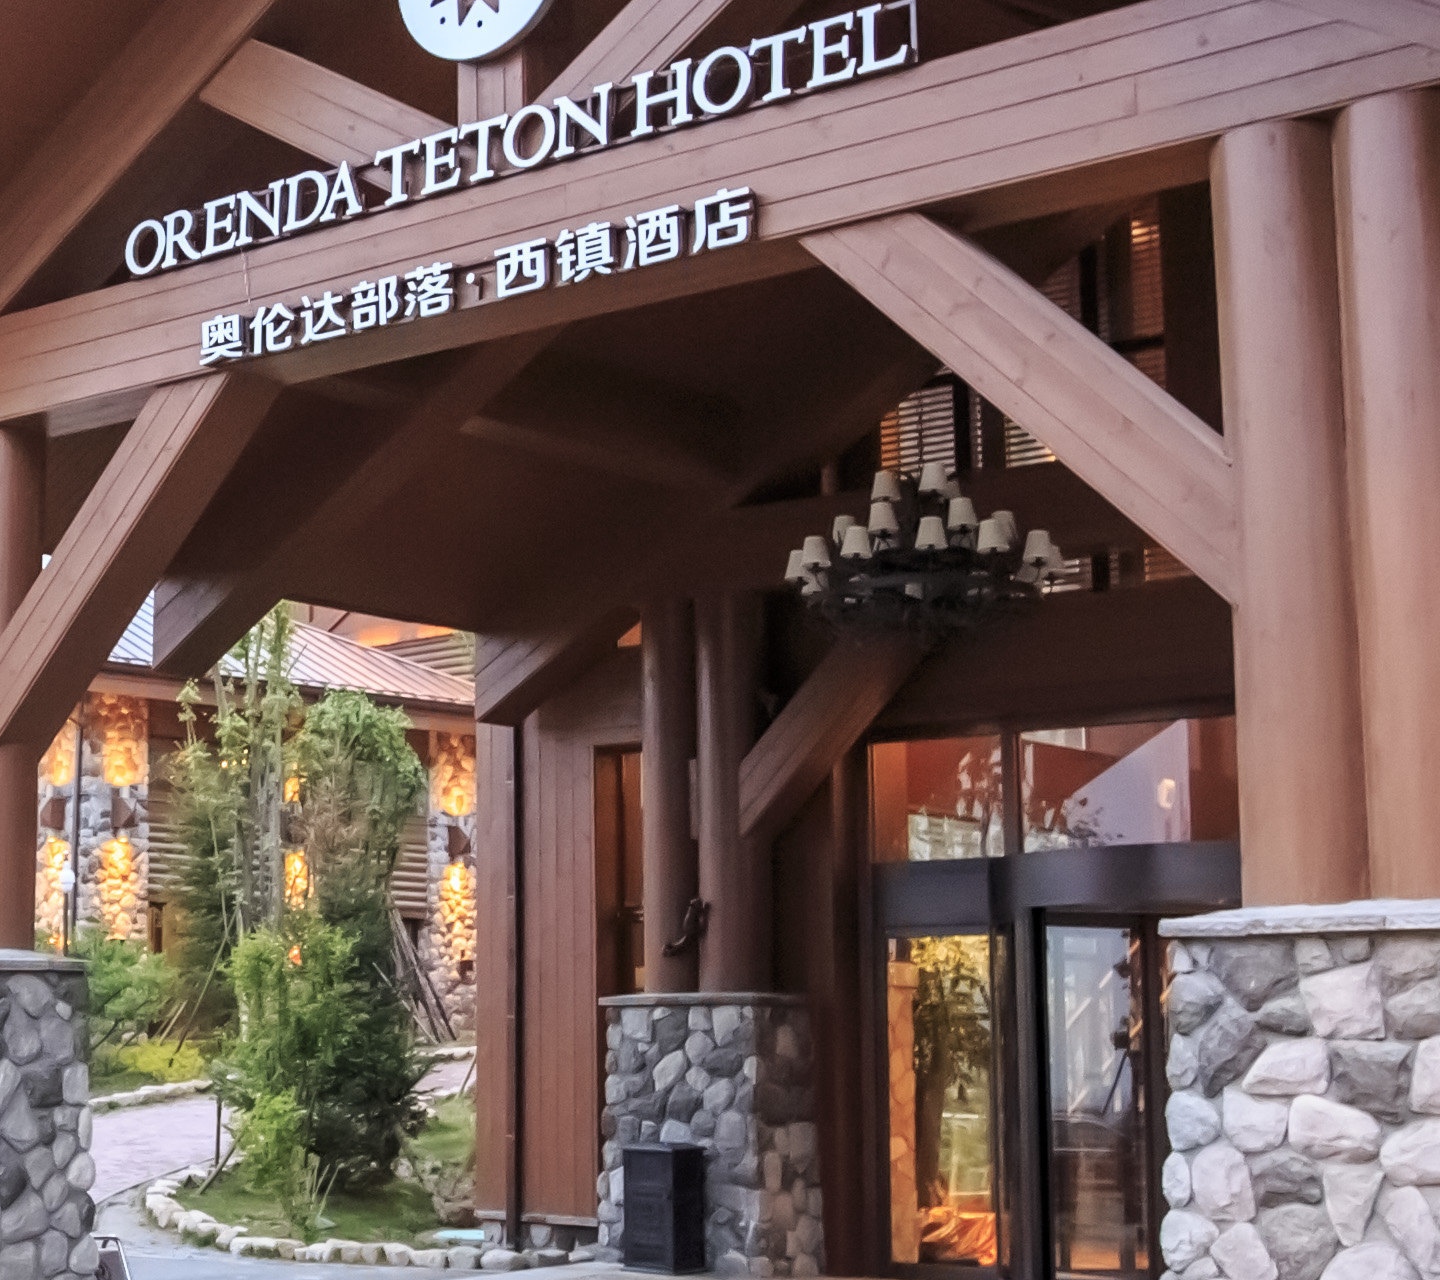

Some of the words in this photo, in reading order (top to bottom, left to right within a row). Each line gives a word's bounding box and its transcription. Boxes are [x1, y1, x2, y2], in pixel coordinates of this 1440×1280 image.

[124, 160, 363, 276] ORENDA
[374, 81, 613, 207] TETON
[630, 2, 909, 138] HOTEL
